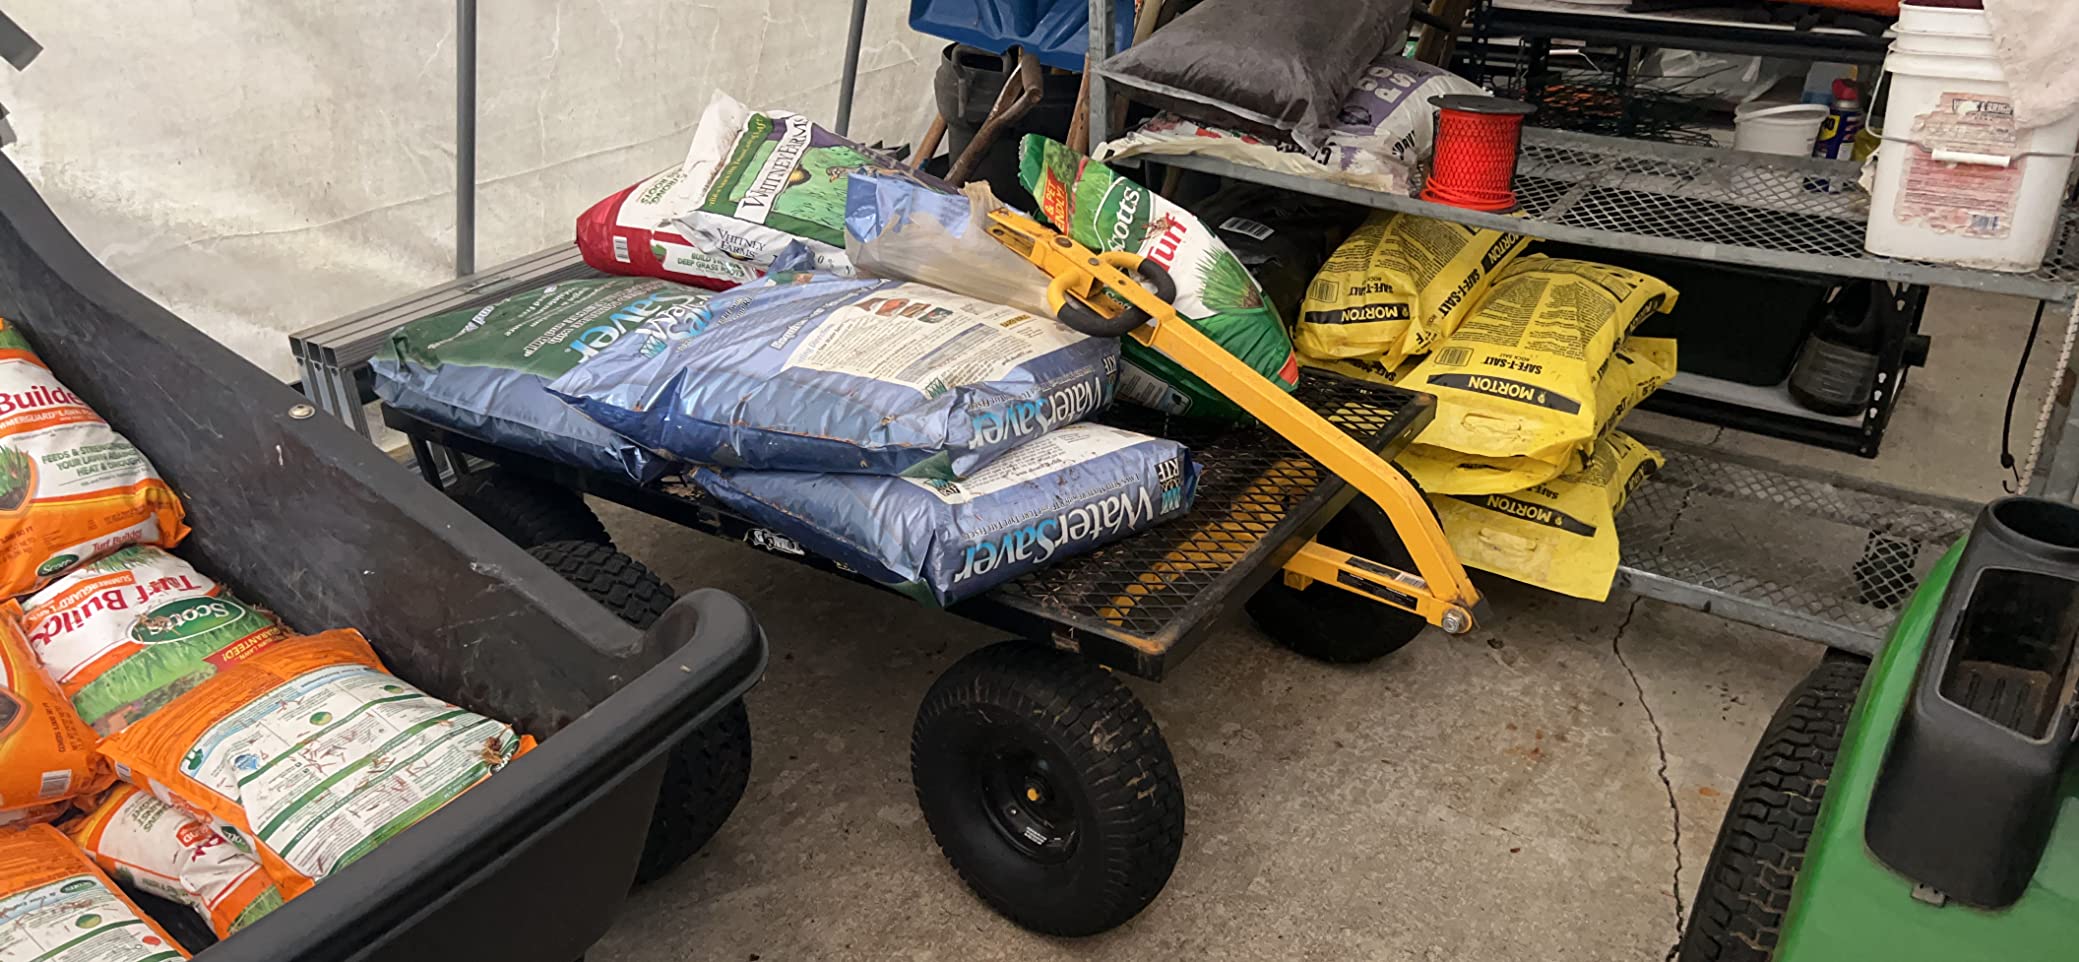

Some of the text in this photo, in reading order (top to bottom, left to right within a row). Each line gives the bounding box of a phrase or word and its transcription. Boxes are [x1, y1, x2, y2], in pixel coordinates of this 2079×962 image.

[1046, 184, 1057, 205] PET
[1055, 186, 1065, 231] ENDLY!
[720, 240, 756, 258] FARMS
[1147, 212, 1187, 272] Turf
[677, 258, 696, 268] DEEP
[697, 261, 722, 272] GRASS
[691, 252, 712, 263] BUILD
[1438, 268, 1479, 317] SAFE-T-SALT
[1340, 305, 1399, 322] MORTON
[1481, 355, 1542, 376] SAFE-T-SALT
[1468, 375, 1535, 400] MORTON
[0, 385, 85, 415] Builde
[969, 376, 1102, 450] WaterSaver
[42, 451, 70, 465] FEEDS
[56, 458, 82, 471] YOUR
[77, 463, 100, 477] HEAT
[1154, 458, 1181, 482] RTF
[1487, 494, 1553, 527] MORTON
[953, 486, 1154, 583] WaterSaver
[135, 575, 202, 602] Turf
[149, 601, 231, 637] Scotts
